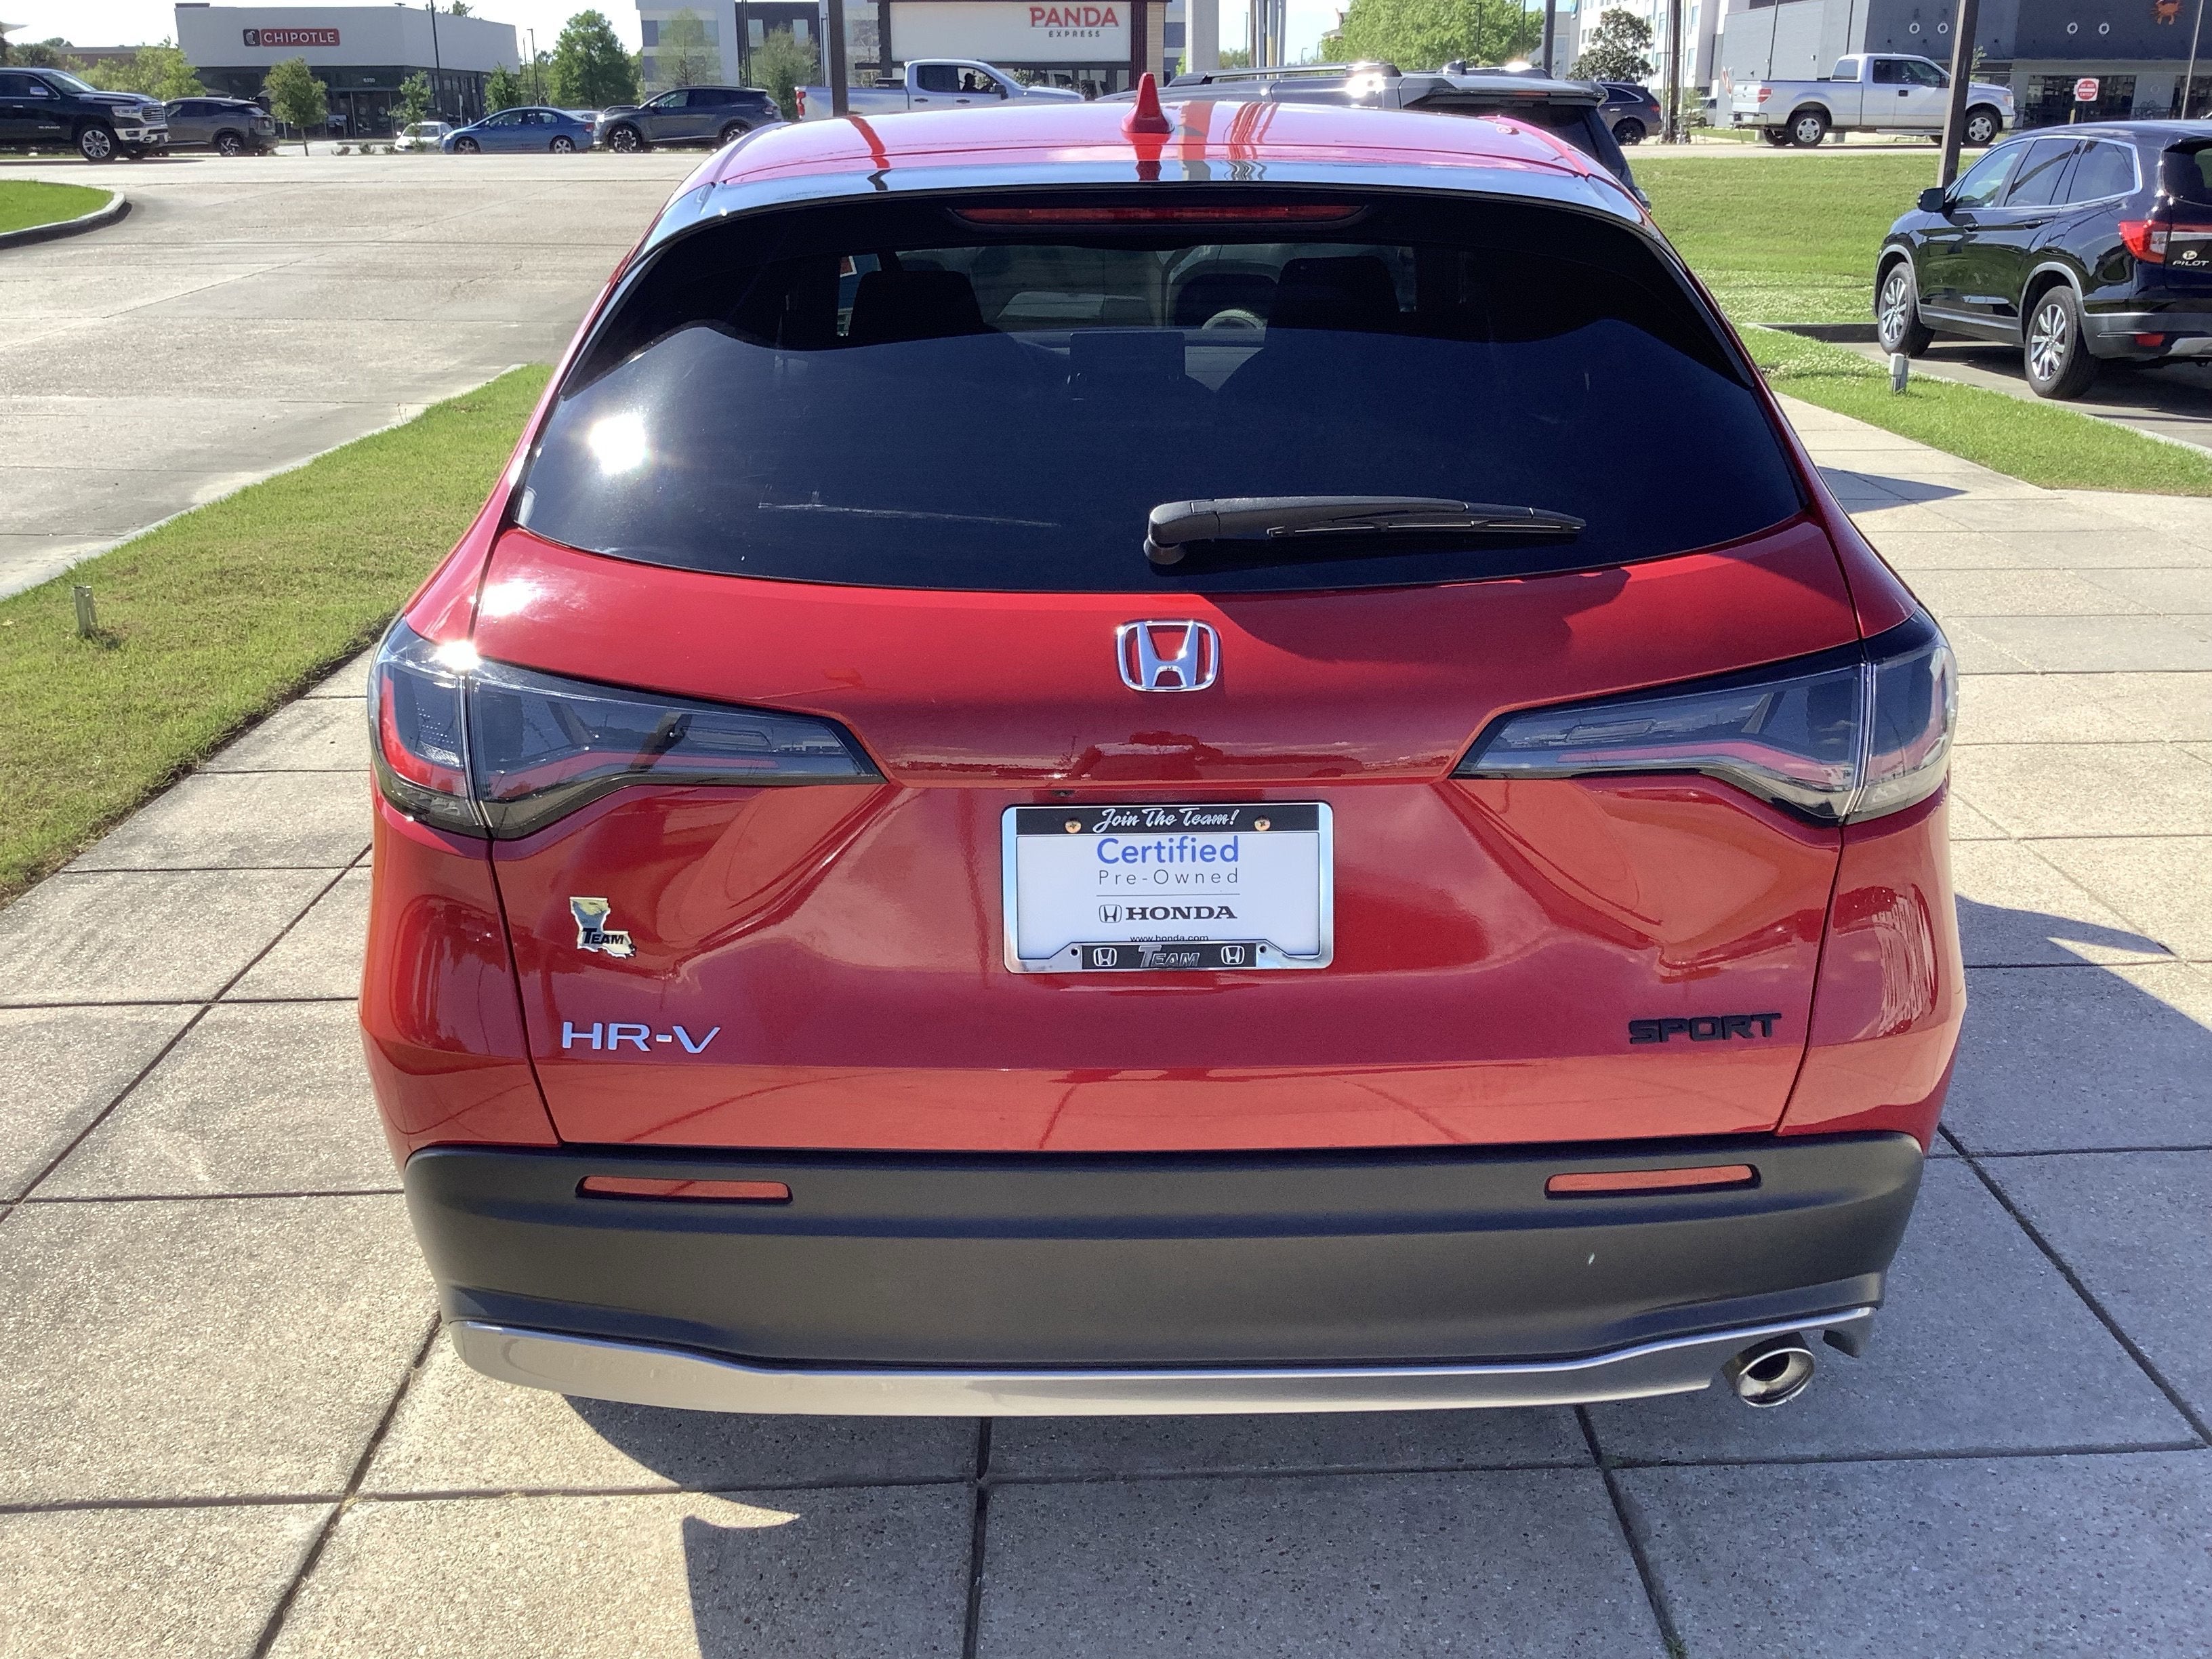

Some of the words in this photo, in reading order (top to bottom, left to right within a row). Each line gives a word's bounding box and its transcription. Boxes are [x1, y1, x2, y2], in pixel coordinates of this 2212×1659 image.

[1029, 7, 1120, 27] PANDA
[264, 32, 336, 43] CHIPOTLE
[1048, 30, 1101, 38] EXPRESS
[1092, 808, 1140, 833] Join
[1141, 808, 1177, 827] The
[1179, 808, 1240, 827] Team!
[1097, 835, 1239, 864] Certified
[1099, 867, 1238, 885] Pre-Owned
[1126, 905, 1237, 920] HONDA
[582, 927, 624, 945] TEAM
[1138, 945, 1200, 968] TEAM
[562, 1020, 721, 1054] HR-V
[1628, 1012, 1782, 1044] SPORT
